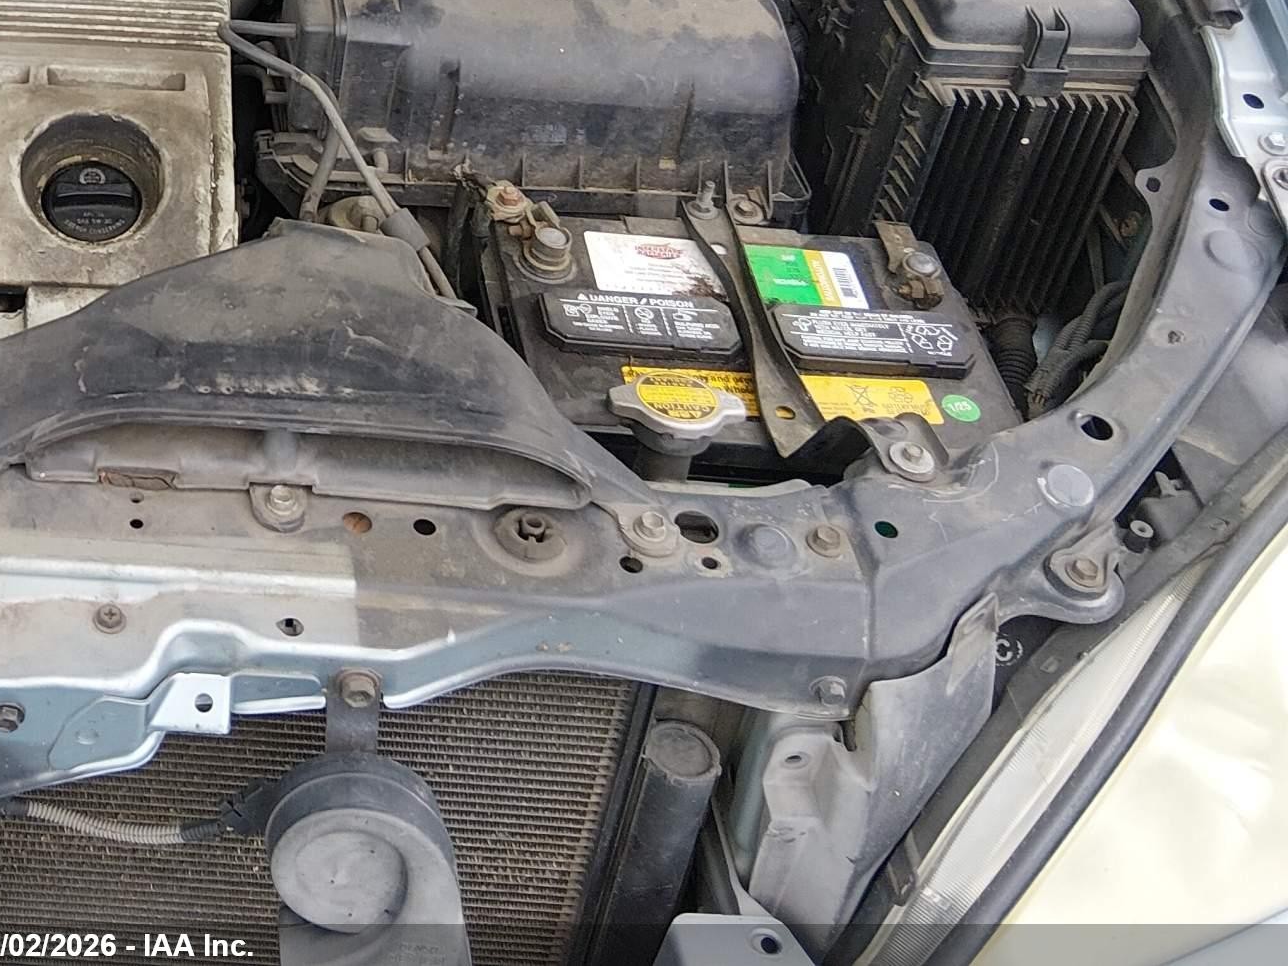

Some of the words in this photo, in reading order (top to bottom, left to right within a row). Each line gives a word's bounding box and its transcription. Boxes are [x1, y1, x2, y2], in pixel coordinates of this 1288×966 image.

[588, 294, 639, 305] DANGER
[648, 298, 694, 308] POISON
[654, 402, 711, 413] CAUTION
